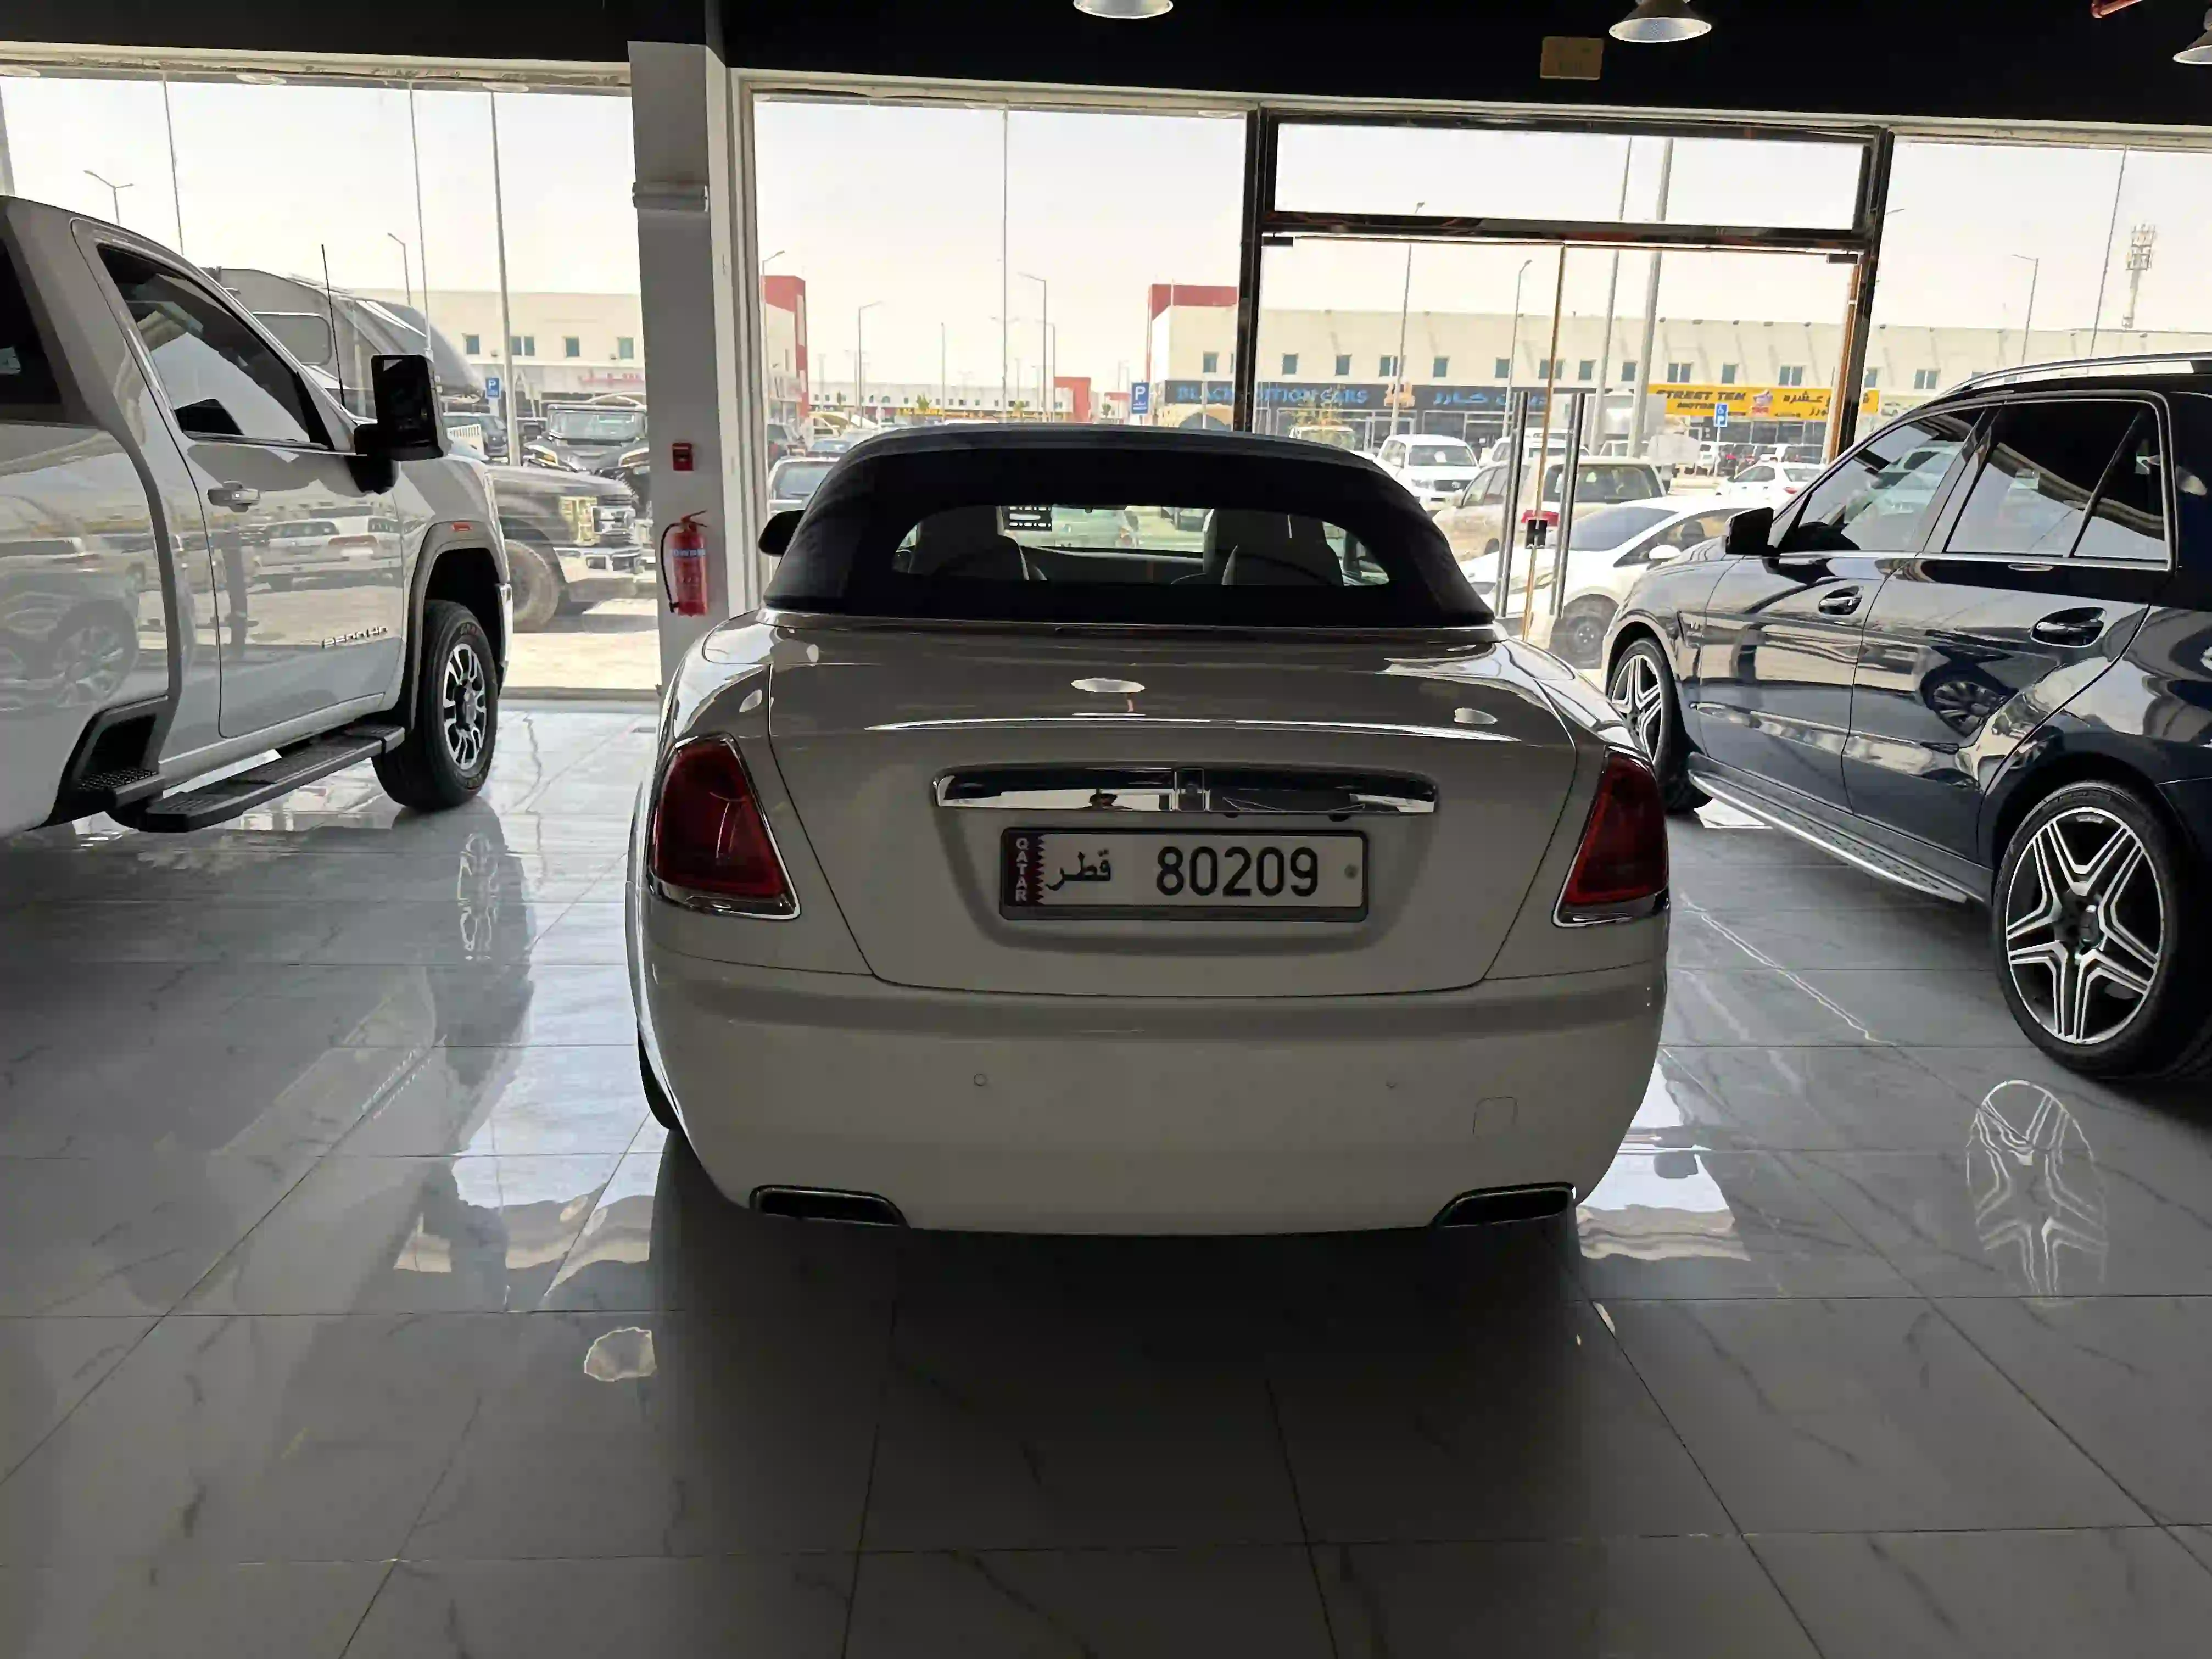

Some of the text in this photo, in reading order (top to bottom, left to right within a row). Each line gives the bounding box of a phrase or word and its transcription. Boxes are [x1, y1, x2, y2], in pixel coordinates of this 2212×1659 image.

[1135, 386, 1146, 400] P
[1015, 837, 1029, 902] QATAR
[1045, 848, 1111, 891] قطر
[1155, 846, 1319, 897] 80209
